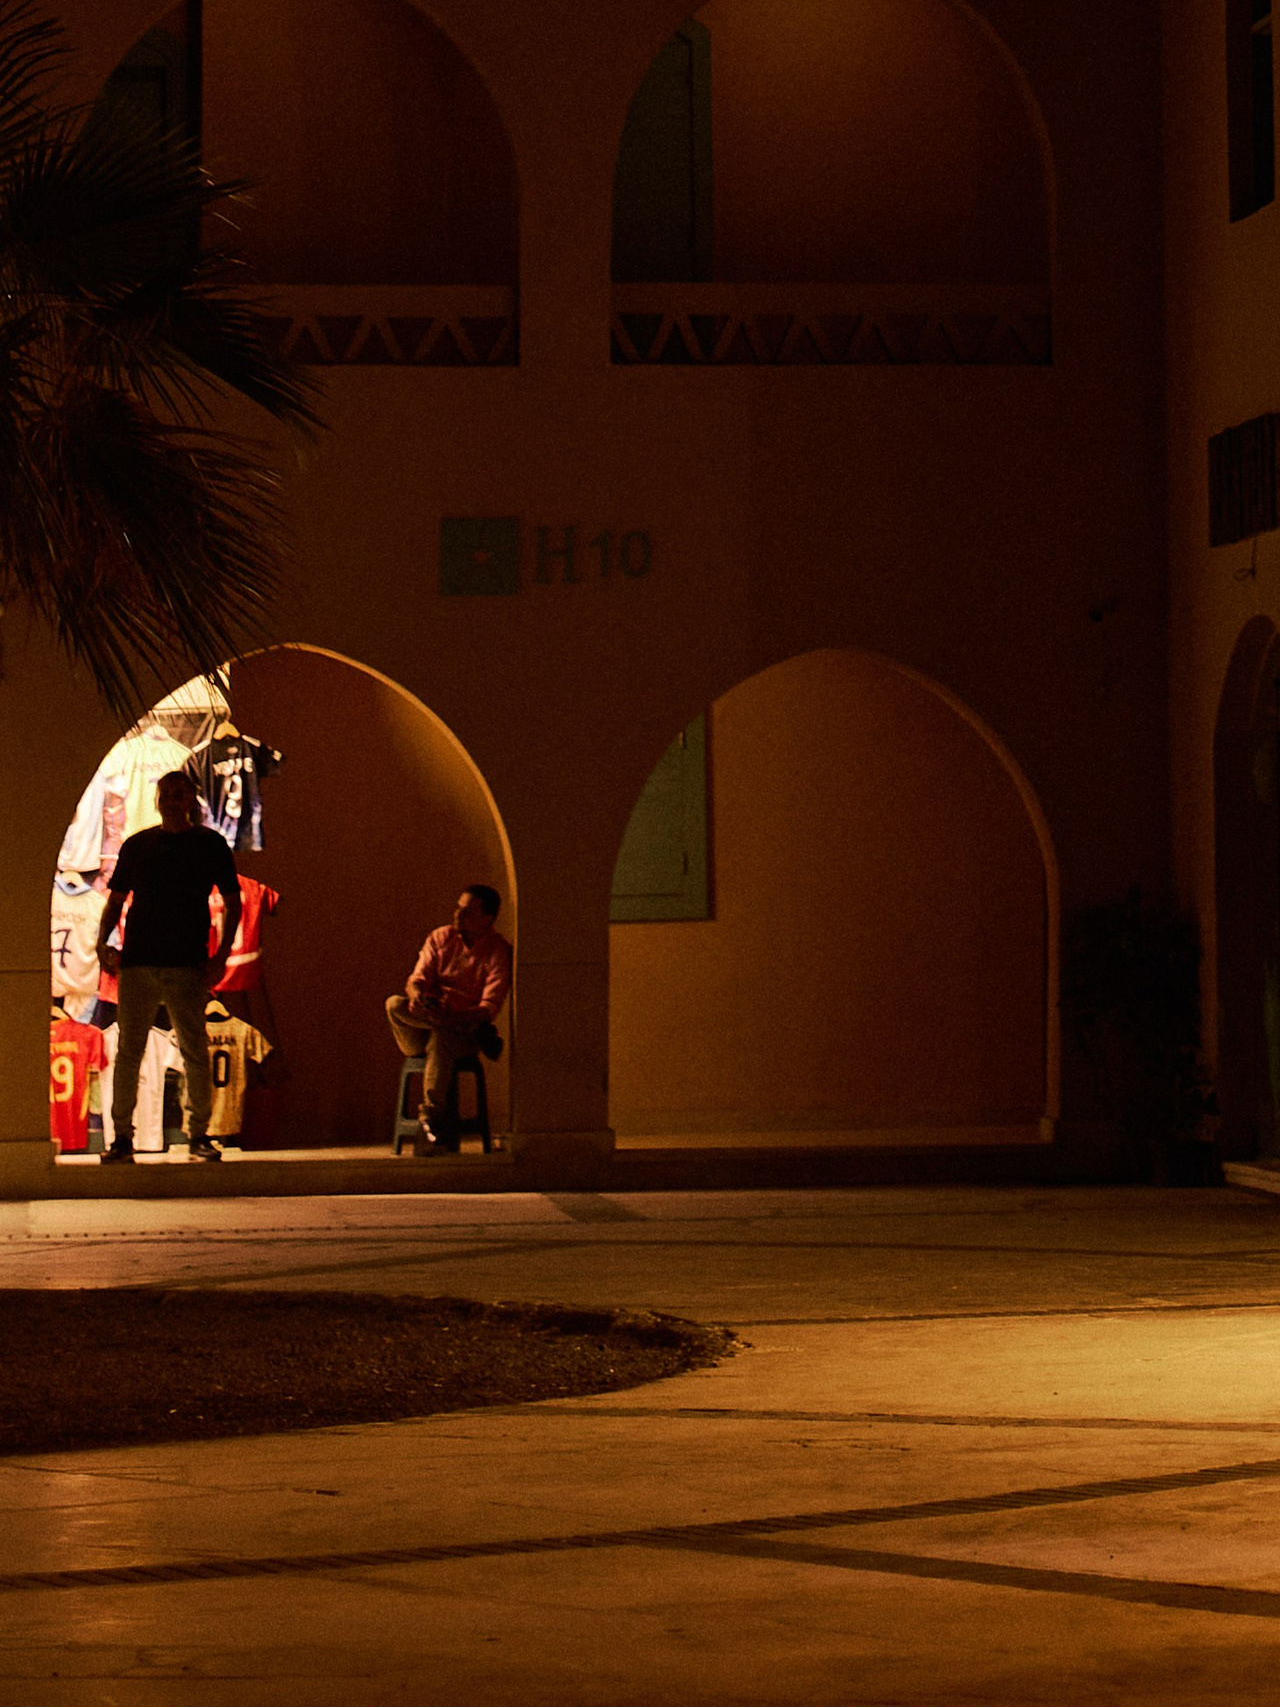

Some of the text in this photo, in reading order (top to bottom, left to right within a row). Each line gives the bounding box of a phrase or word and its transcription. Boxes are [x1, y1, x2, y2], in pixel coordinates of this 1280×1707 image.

[533, 526, 651, 584] H 10
[54, 928, 72, 969] 7
